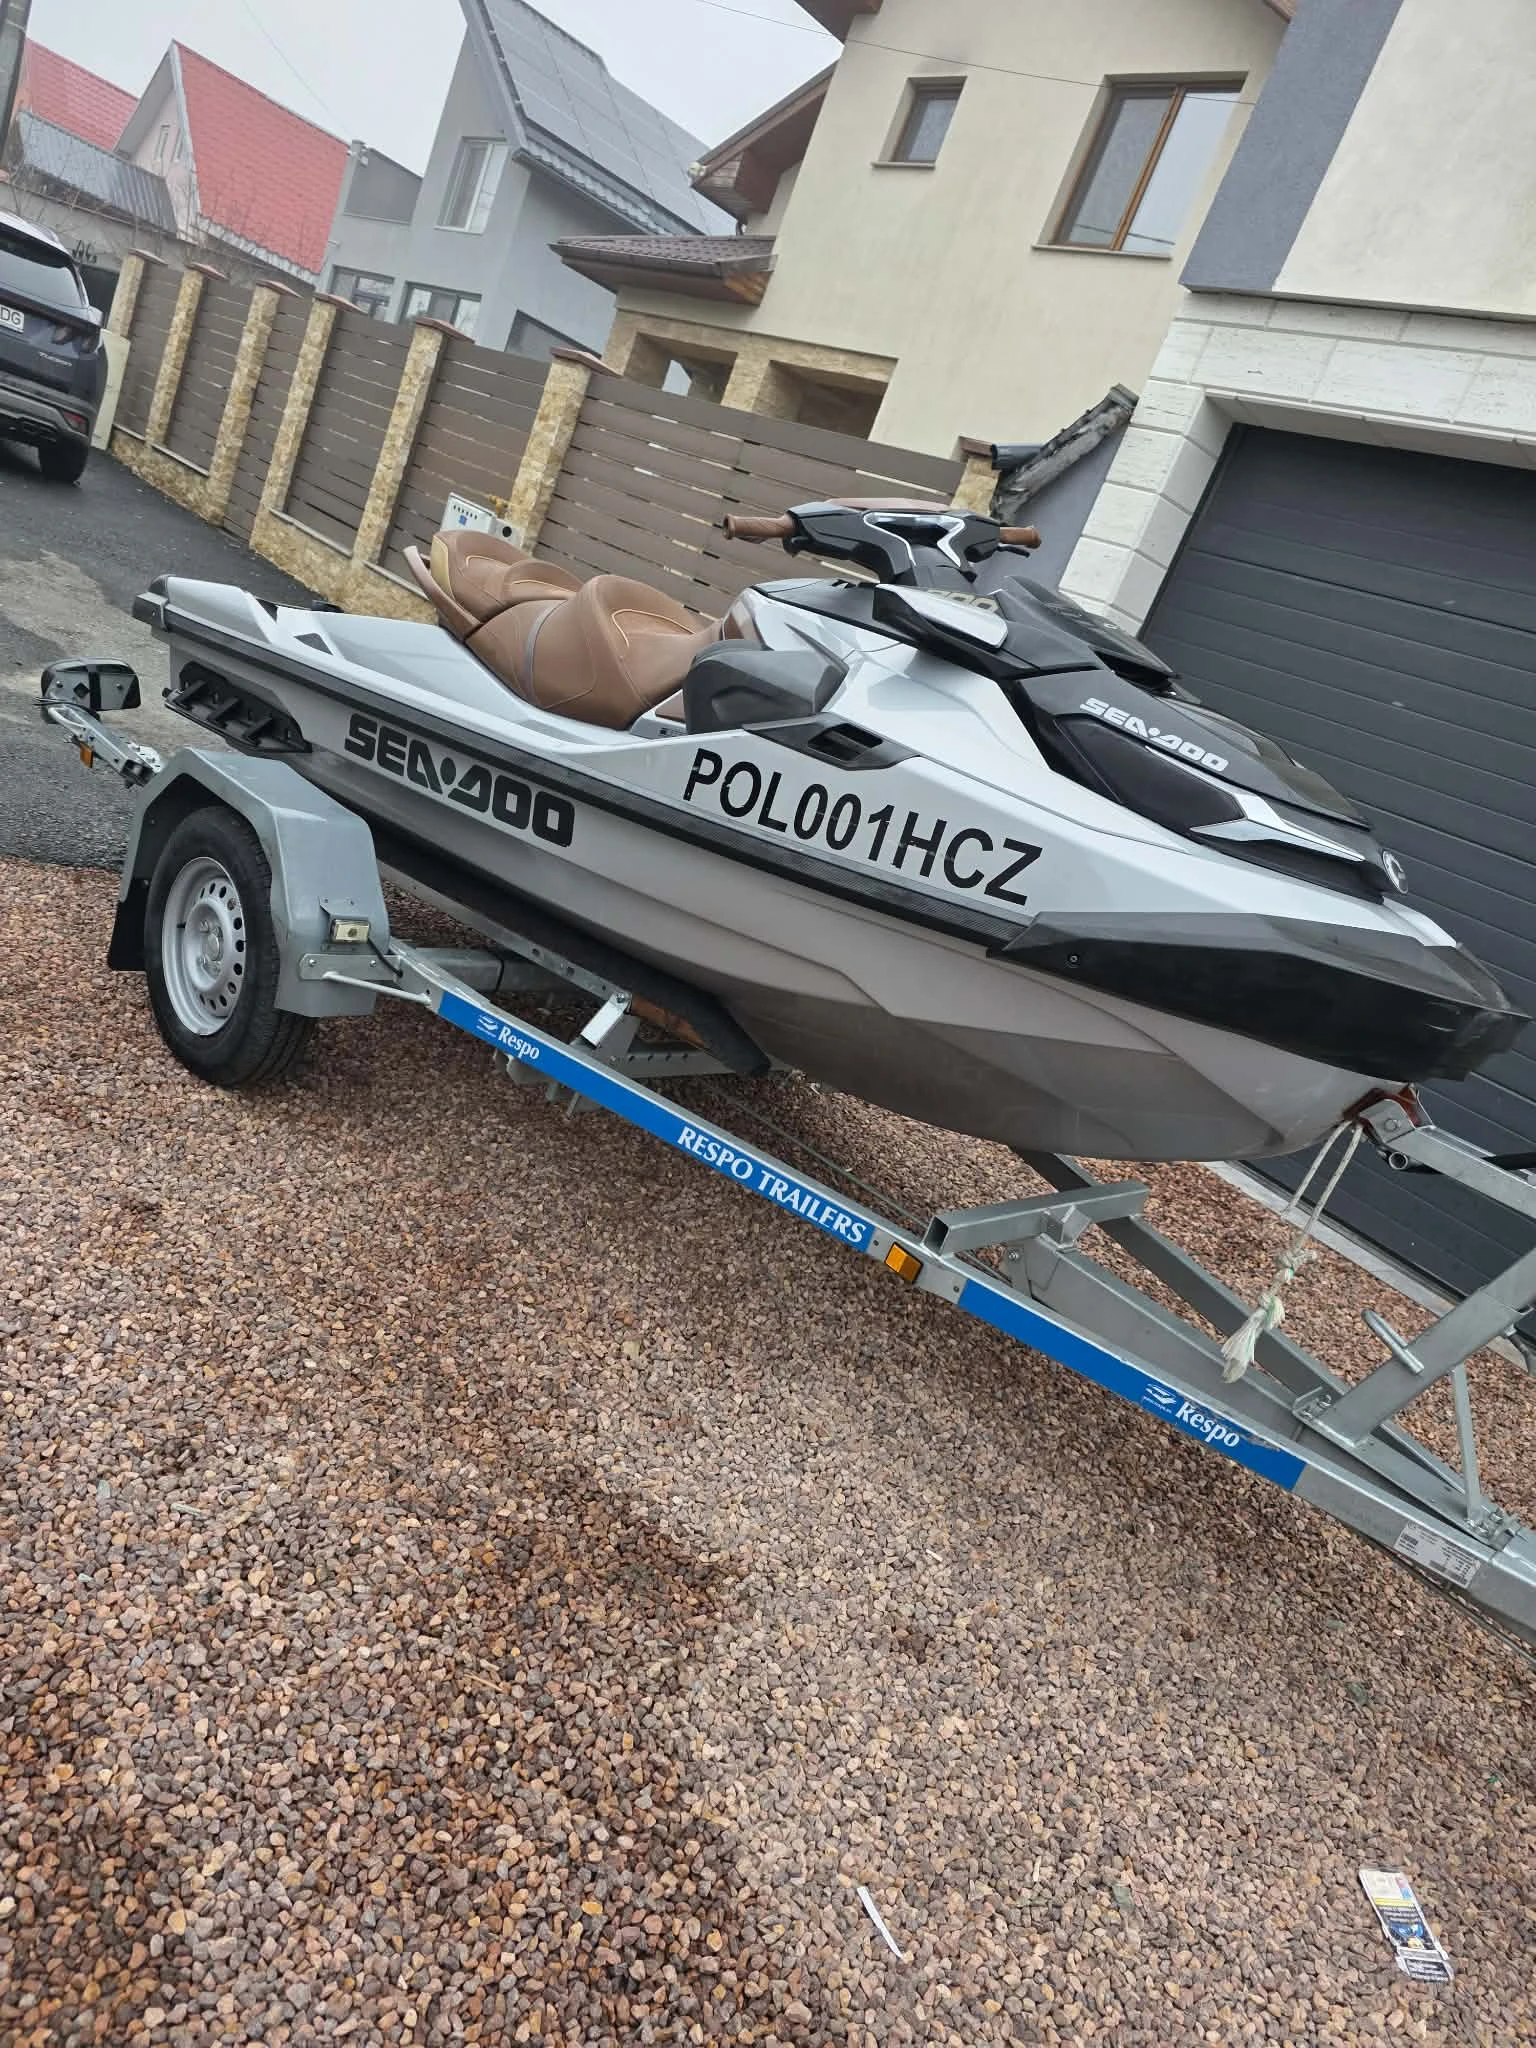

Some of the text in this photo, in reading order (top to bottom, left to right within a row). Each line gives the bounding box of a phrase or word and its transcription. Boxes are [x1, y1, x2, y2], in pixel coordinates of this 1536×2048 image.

[682, 747, 1043, 906] POL001HCZ
[498, 1025, 540, 1060] Respo
[677, 1125, 867, 1243] RESPO TRAILERS
[1175, 1401, 1240, 1447] Respo
